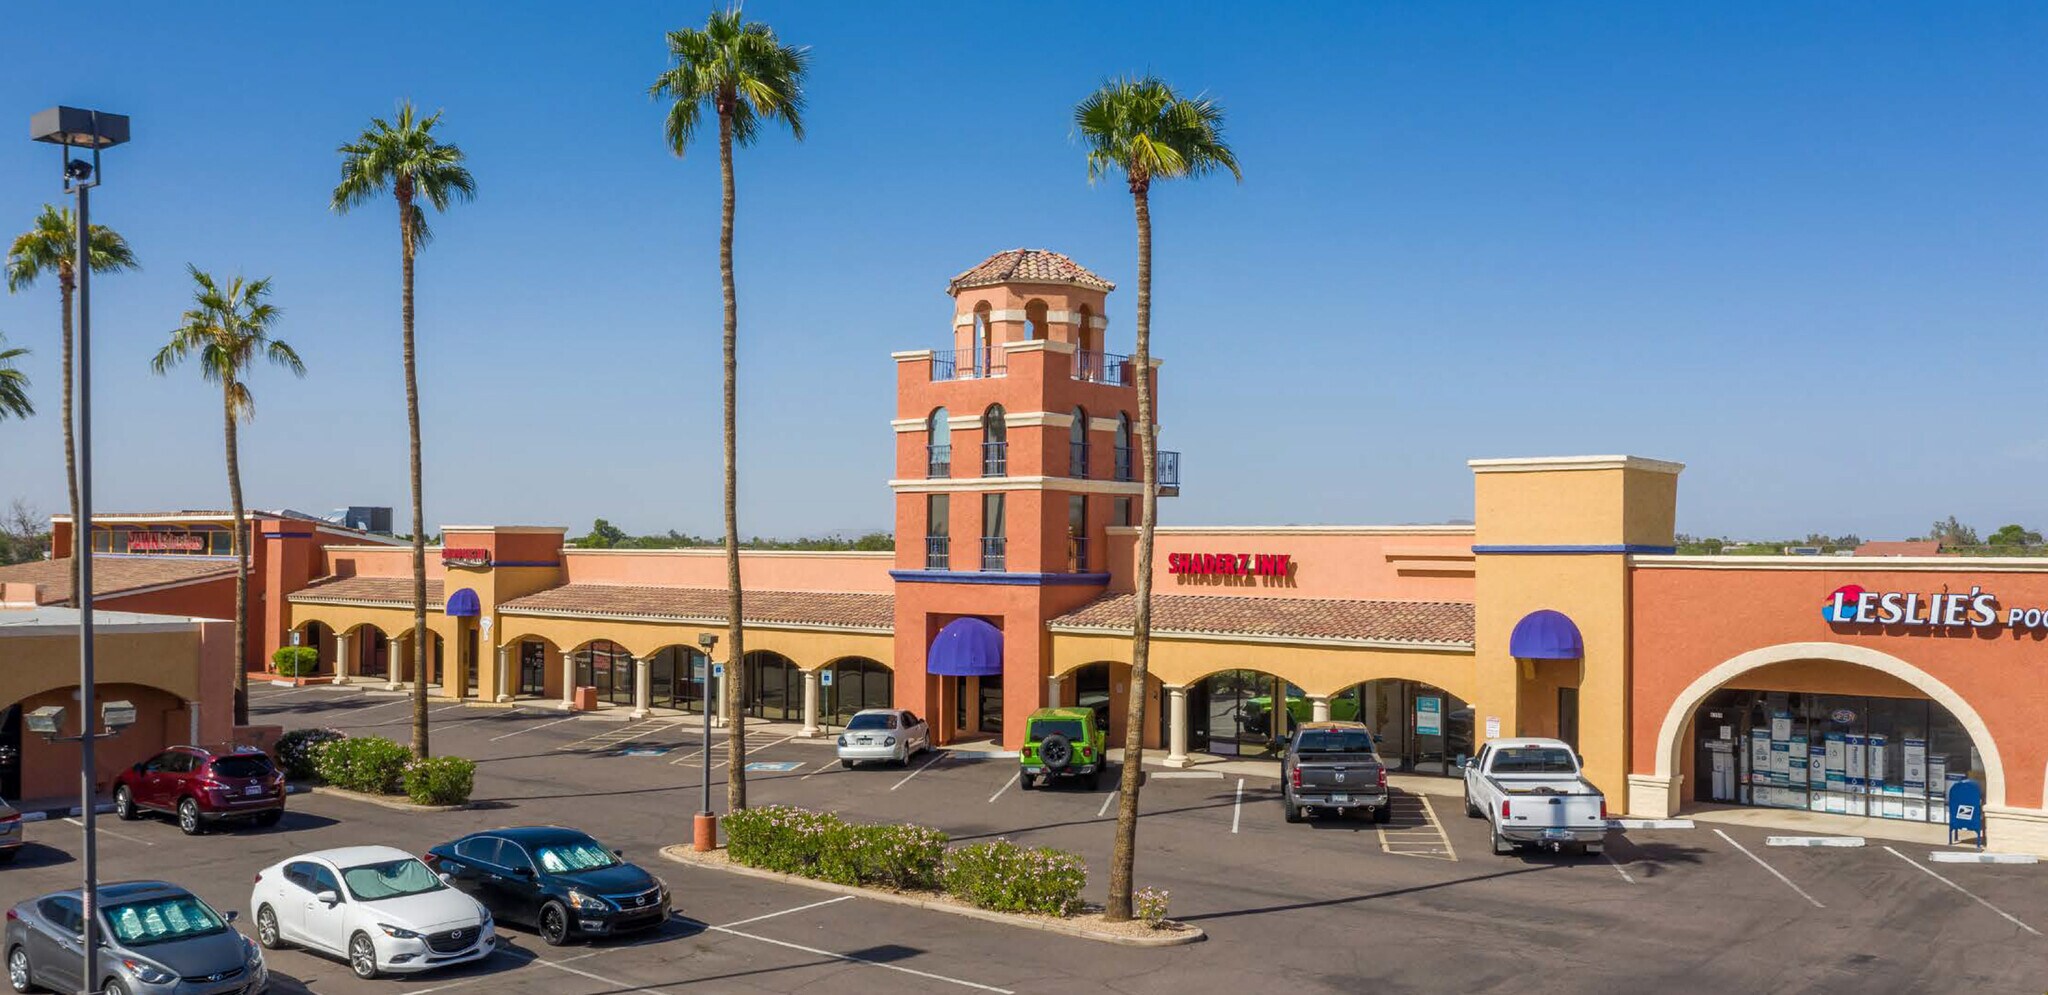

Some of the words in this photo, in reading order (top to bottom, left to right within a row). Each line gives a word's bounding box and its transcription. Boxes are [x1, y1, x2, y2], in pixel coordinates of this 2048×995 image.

[1168, 553, 1250, 576] SHADERZ
[1254, 554, 1291, 576] INK
[1832, 586, 1997, 627] LESLIE'S
